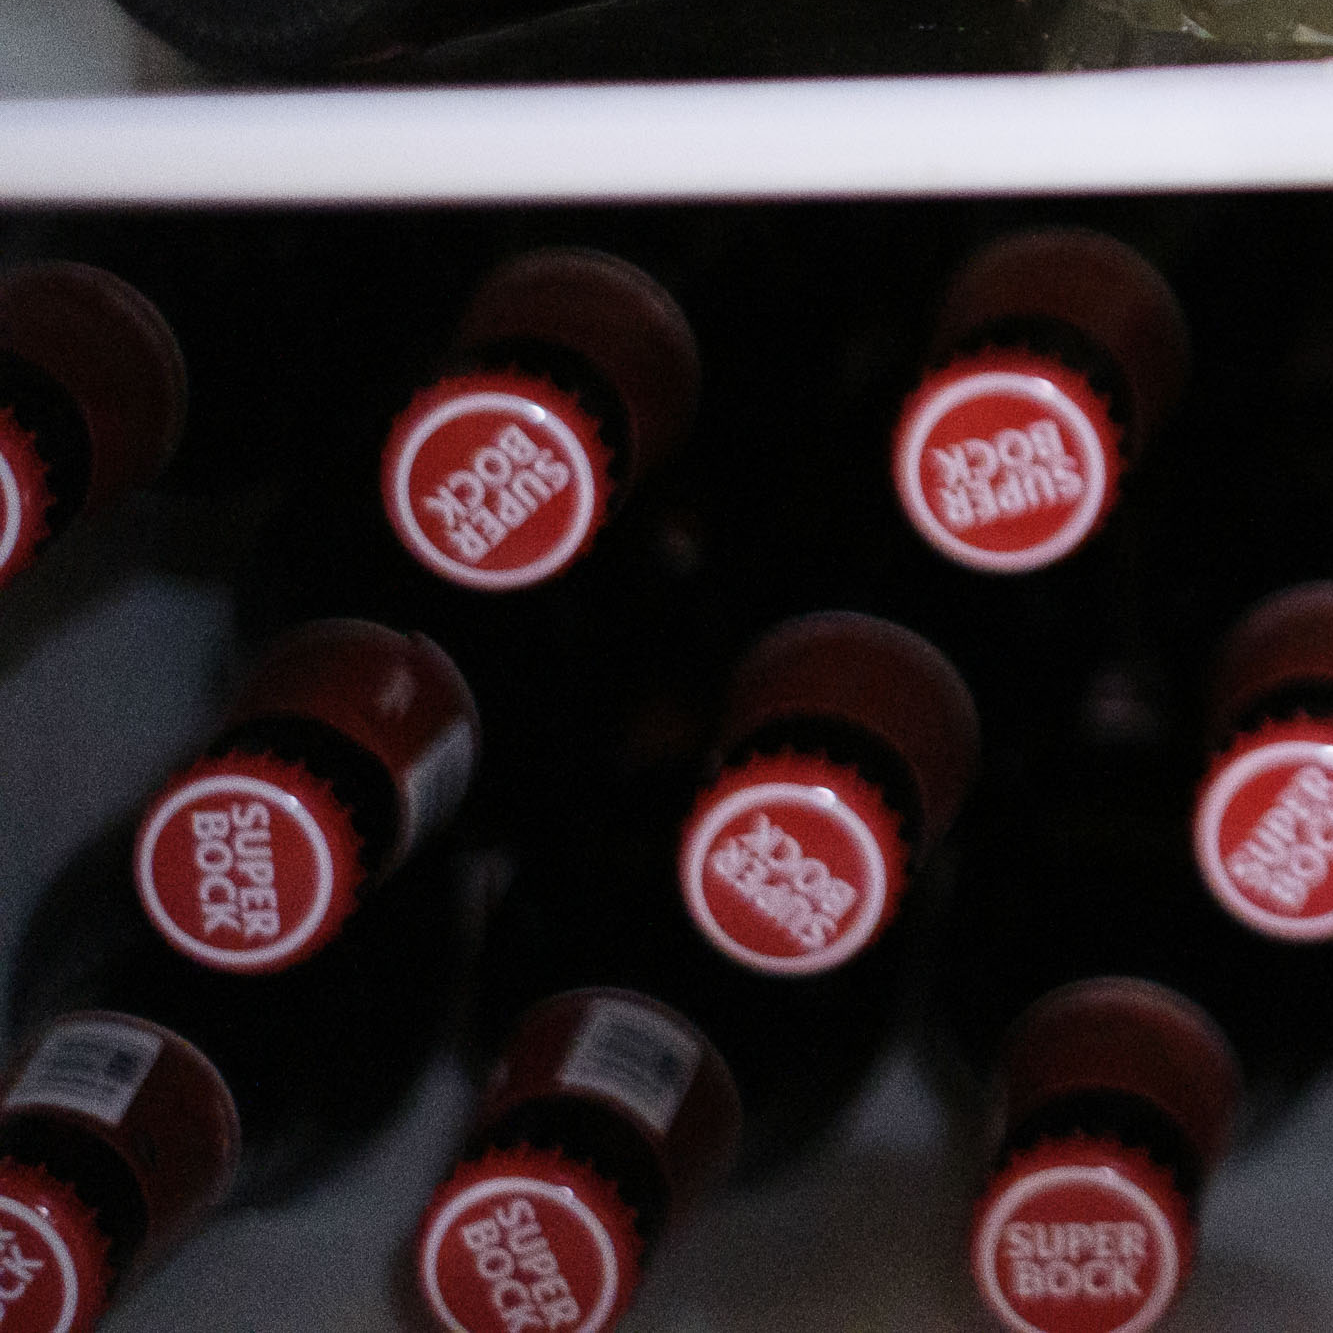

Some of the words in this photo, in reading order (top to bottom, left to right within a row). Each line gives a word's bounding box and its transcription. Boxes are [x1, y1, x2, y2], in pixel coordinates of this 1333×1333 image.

[425, 424, 538, 537] BOCK
[449, 448, 569, 560] SUPER
[934, 420, 1066, 485] BOCK
[939, 455, 1081, 528] SUPER
[192, 811, 242, 932] BOCK
[230, 802, 280, 937] SUPER
[711, 839, 836, 947] SUPER
[740, 814, 857, 922] BOCK
[460, 1219, 543, 1333] BOCK
[493, 1198, 579, 1329] SUPER
[1005, 1222, 1147, 1261] SUPER
[1012, 1259, 1140, 1299] BOCK
